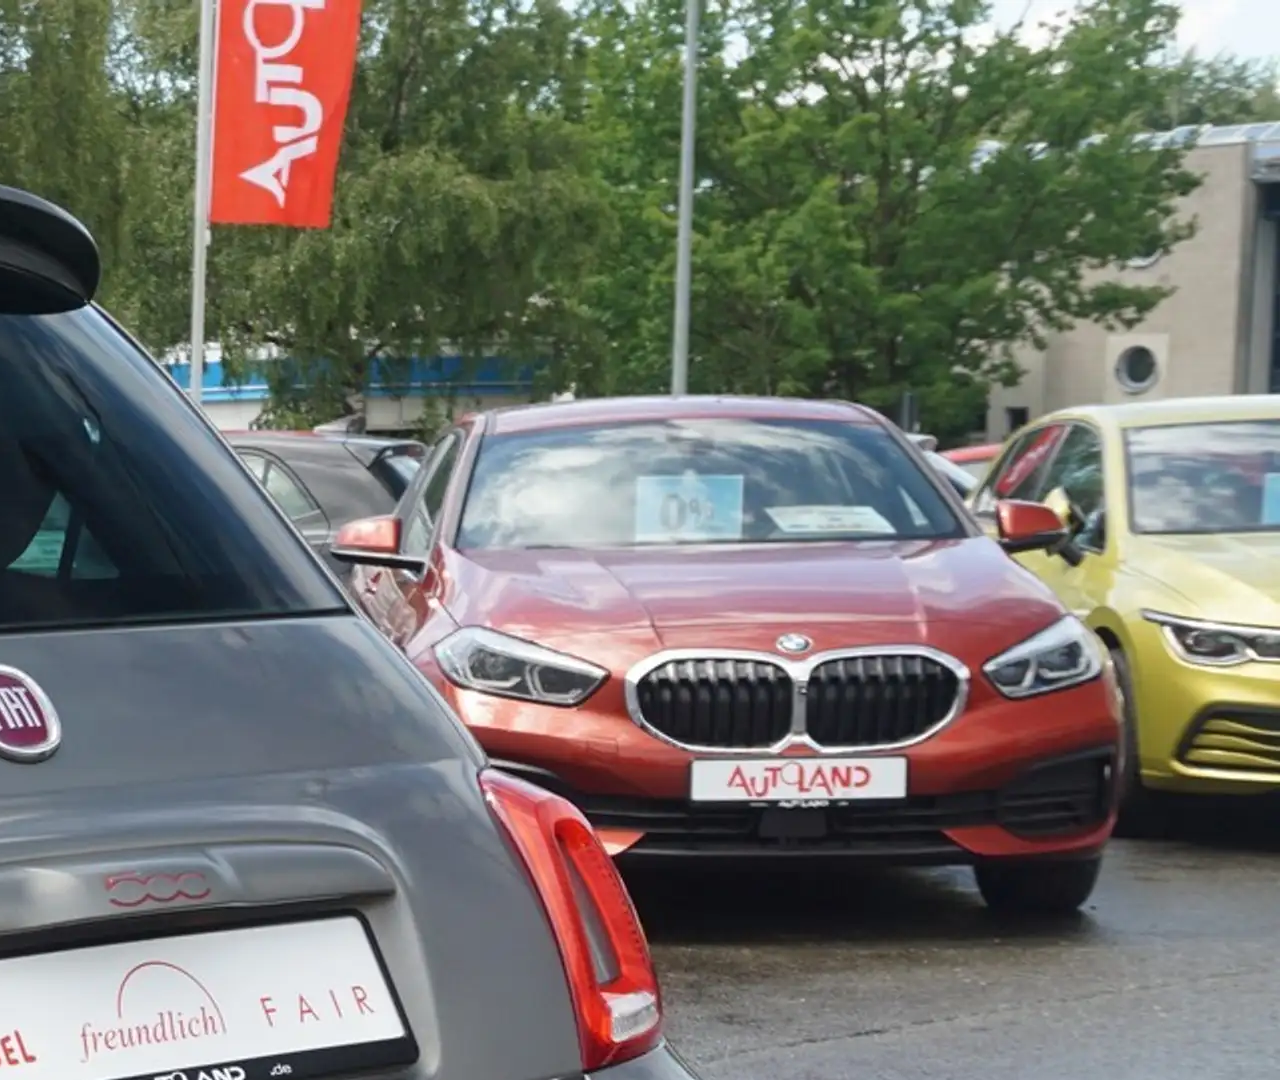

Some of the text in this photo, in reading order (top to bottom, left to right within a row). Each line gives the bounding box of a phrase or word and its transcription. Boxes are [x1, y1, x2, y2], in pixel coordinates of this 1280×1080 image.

[727, 761, 872, 797] AUTOLAND
[104, 870, 211, 907] 500
[80, 1006, 217, 1063] freundlich
[260, 985, 375, 1027] FAIR
[270, 1063, 292, 1076] .de
